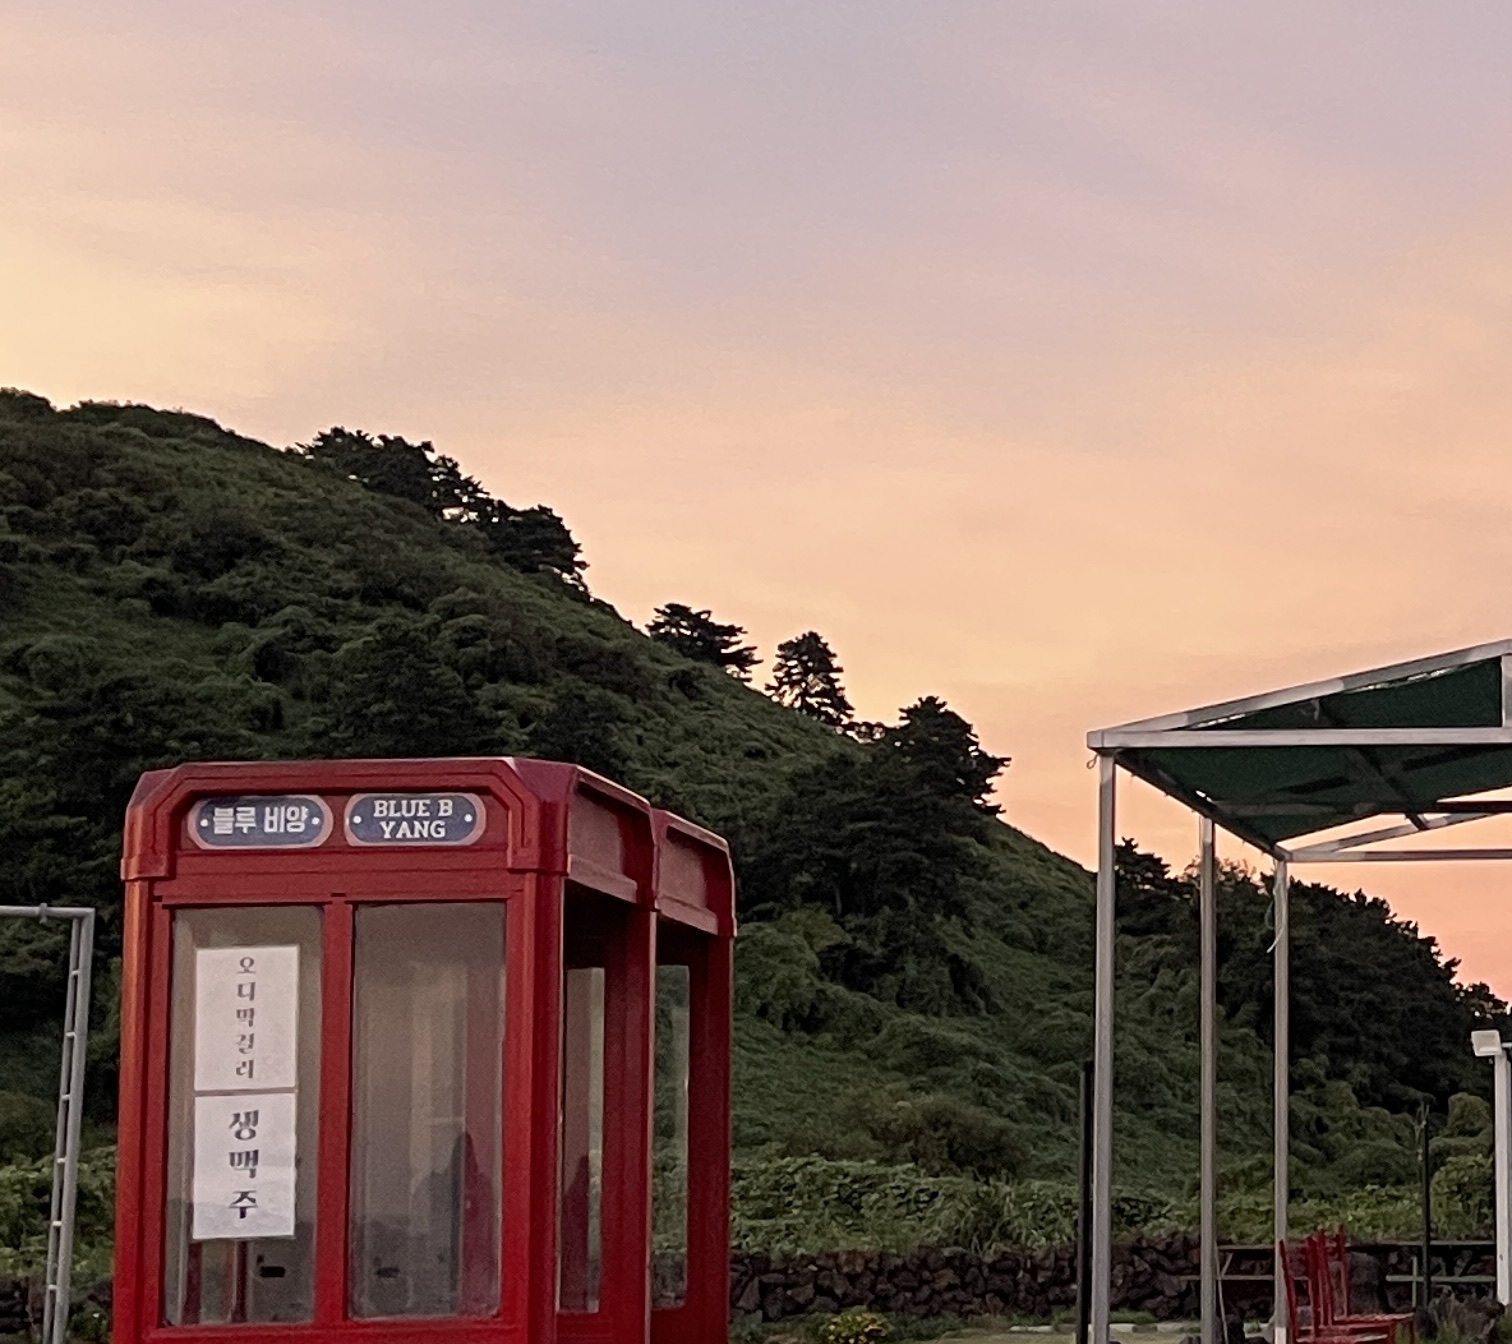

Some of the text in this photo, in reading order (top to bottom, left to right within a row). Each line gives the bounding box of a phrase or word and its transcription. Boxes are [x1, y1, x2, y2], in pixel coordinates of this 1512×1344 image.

[213, 806, 309, 834] 블루 비양
[373, 799, 453, 818] BLUE B
[379, 820, 446, 839] YANG
[228, 1109, 260, 1220] 생맥주
